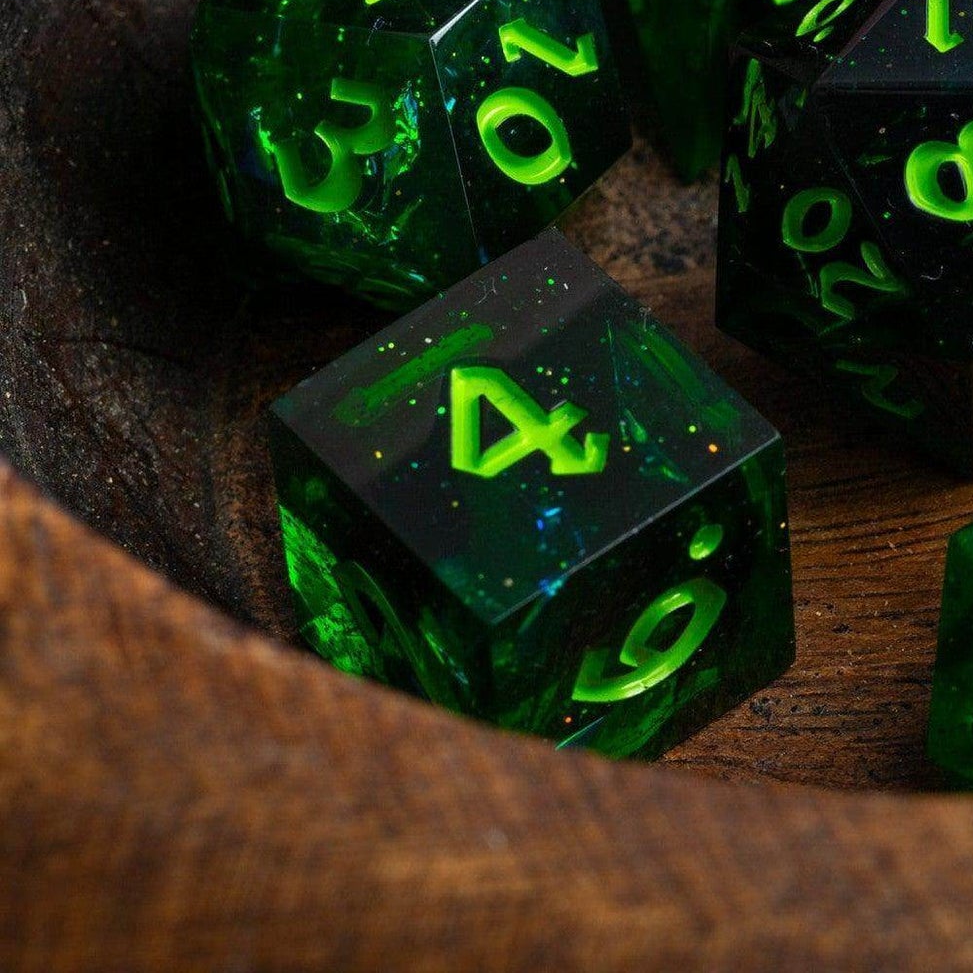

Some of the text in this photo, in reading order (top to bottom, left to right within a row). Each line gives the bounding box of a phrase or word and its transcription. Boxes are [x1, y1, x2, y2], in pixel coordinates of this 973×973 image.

[268, 78, 400, 213] 3
[476, 18, 599, 186] 10
[781, 187, 908, 320] 20
[449, 366, 611, 478] 4
